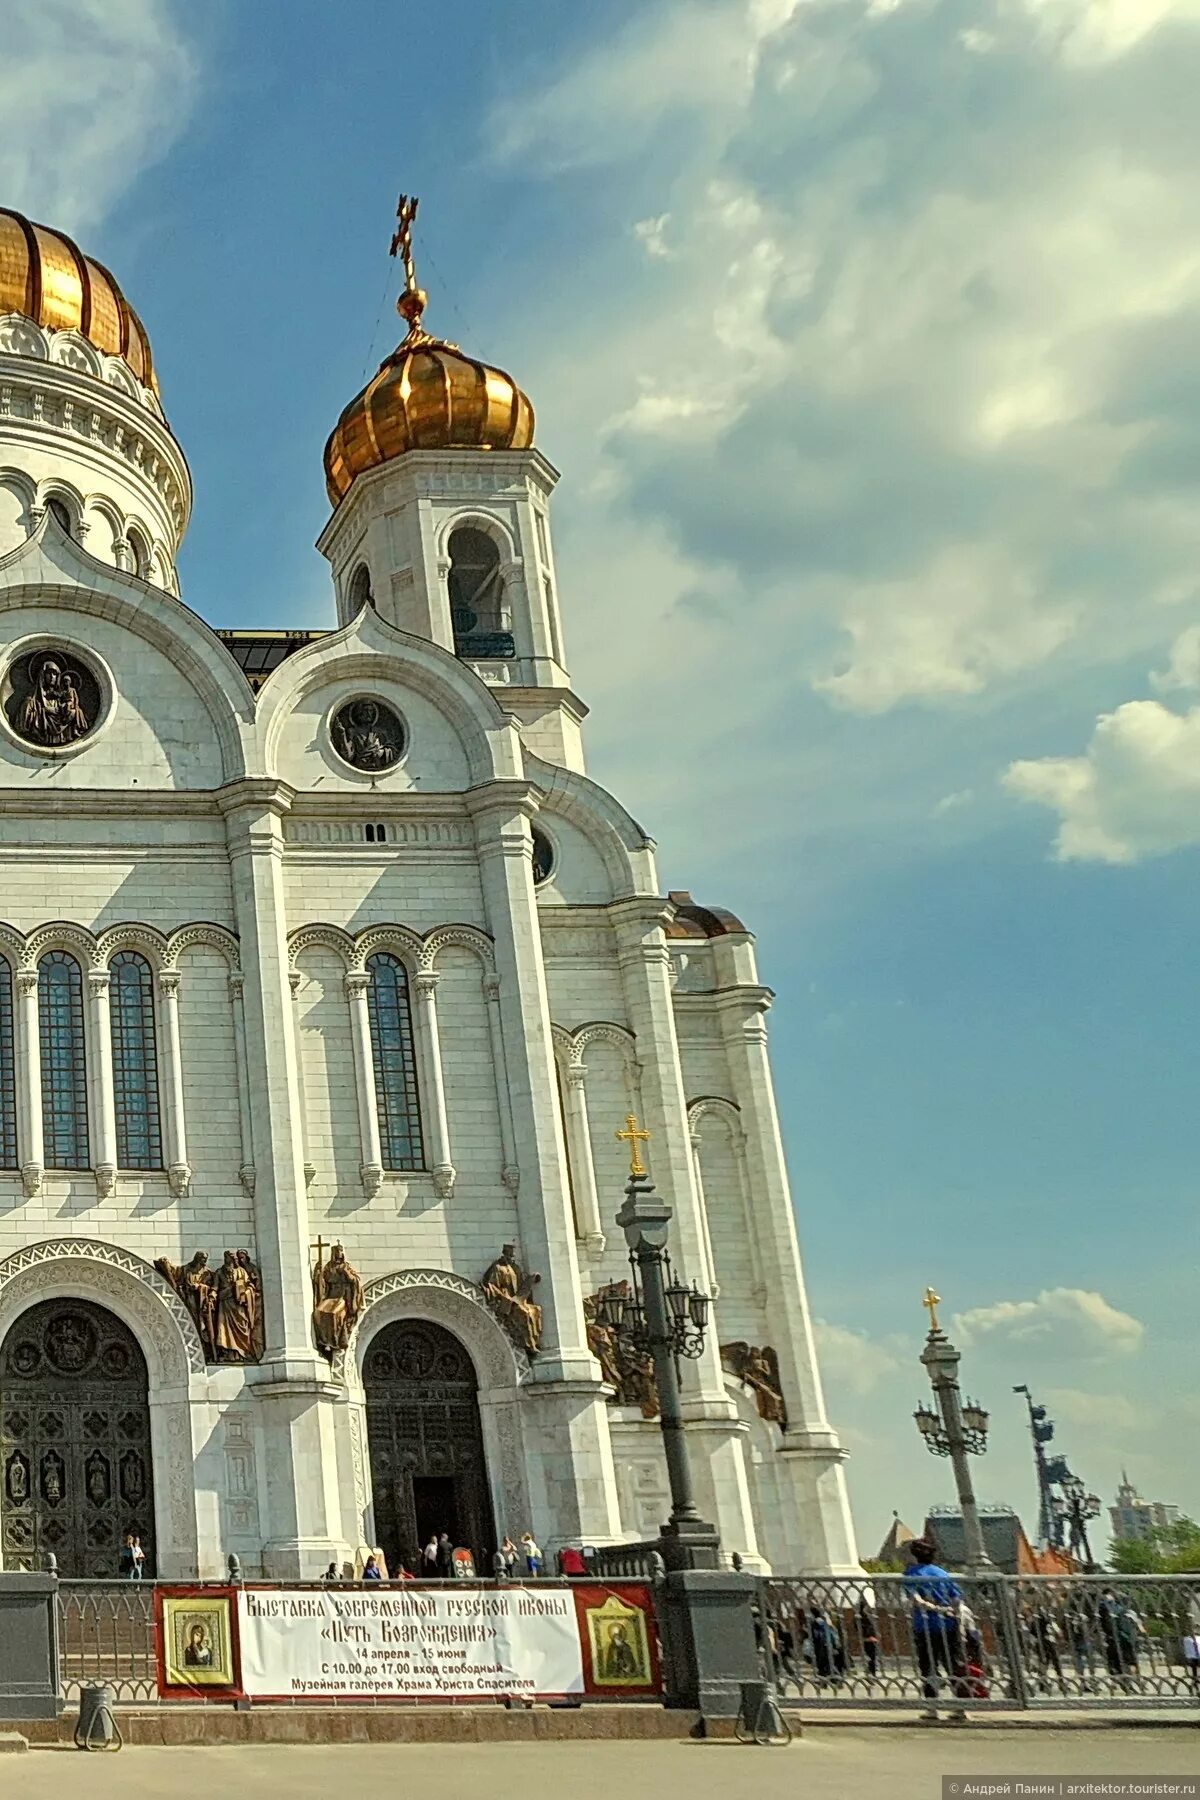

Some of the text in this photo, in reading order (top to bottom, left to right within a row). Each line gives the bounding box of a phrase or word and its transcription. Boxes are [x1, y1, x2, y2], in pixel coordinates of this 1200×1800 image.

[356, 1648, 368, 1659] 14
[371, 1650, 410, 1661] апреля
[421, 1648, 434, 1659] 15
[437, 1650, 467, 1659] июня
[321, 1662, 504, 1676] С 10.00 до 17.00 вход свободный
[291, 1677, 535, 1692] Музейная галерея Храма Христа Спасителя
